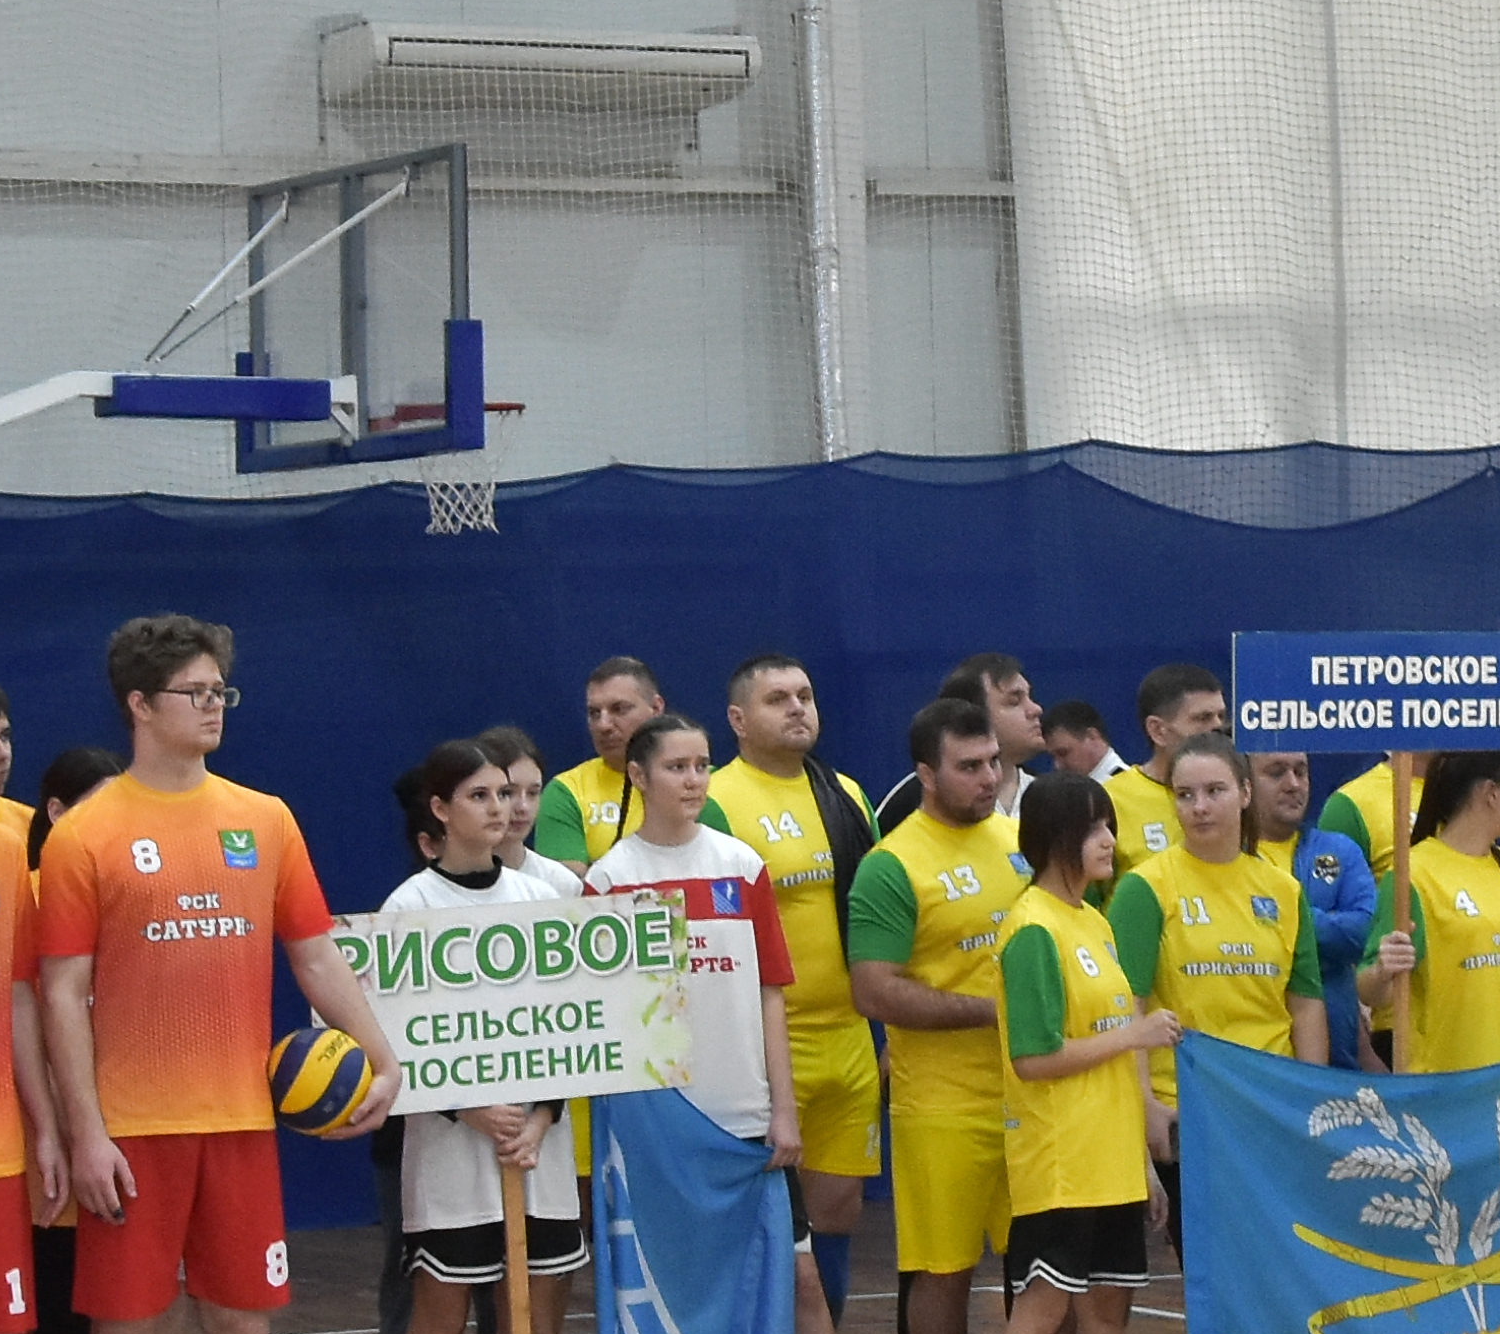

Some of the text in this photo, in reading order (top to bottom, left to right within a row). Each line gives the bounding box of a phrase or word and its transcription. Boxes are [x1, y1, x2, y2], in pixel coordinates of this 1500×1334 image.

[1311, 655, 1498, 686] ПЕТРОВСКОЕ
[1240, 699, 1394, 730] СЕЛЬСКОЕ
[758, 811, 804, 843] 14
[1141, 821, 1169, 853] 5
[131, 838, 163, 874] 8
[937, 864, 982, 902] 13
[177, 893, 221, 911] ФСК
[1180, 895, 1212, 926] 11
[1454, 888, 1480, 917] 4
[1075, 945, 1101, 979] 6
[404, 999, 606, 1048] СЕЛЬСКОЕ
[400, 1040, 625, 1092] ПОСЕЛЕНИЕ
[264, 1239, 291, 1288] 8
